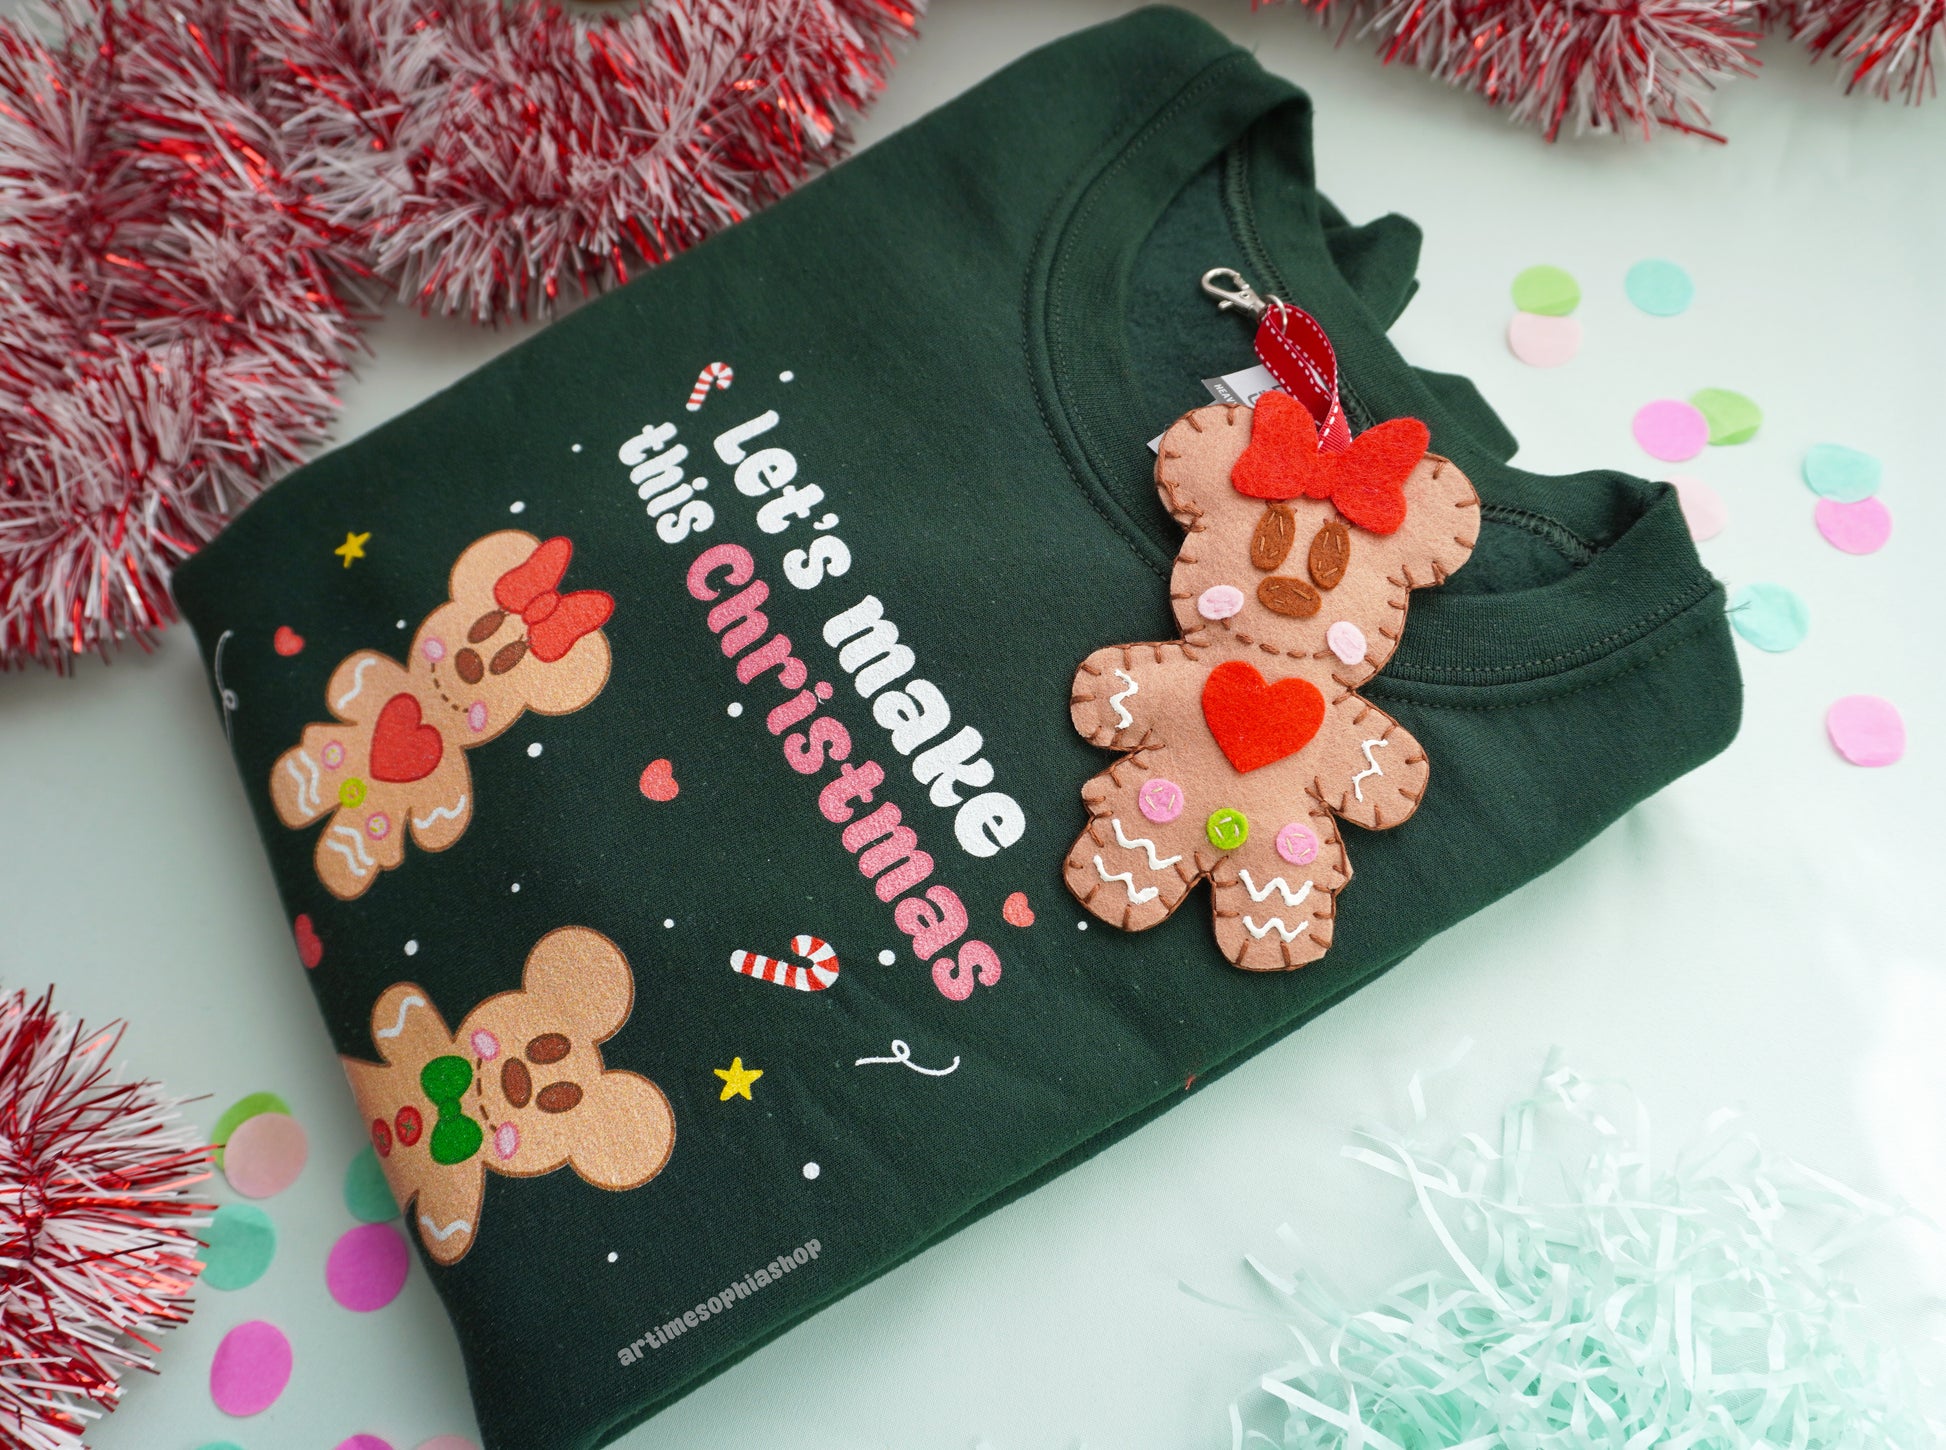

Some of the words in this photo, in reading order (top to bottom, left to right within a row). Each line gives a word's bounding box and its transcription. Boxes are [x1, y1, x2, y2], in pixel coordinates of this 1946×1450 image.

[618, 421, 715, 544] this
[686, 543, 1002, 1001] Christmas
[713, 409, 851, 590] Let's
[823, 594, 1026, 858] make
